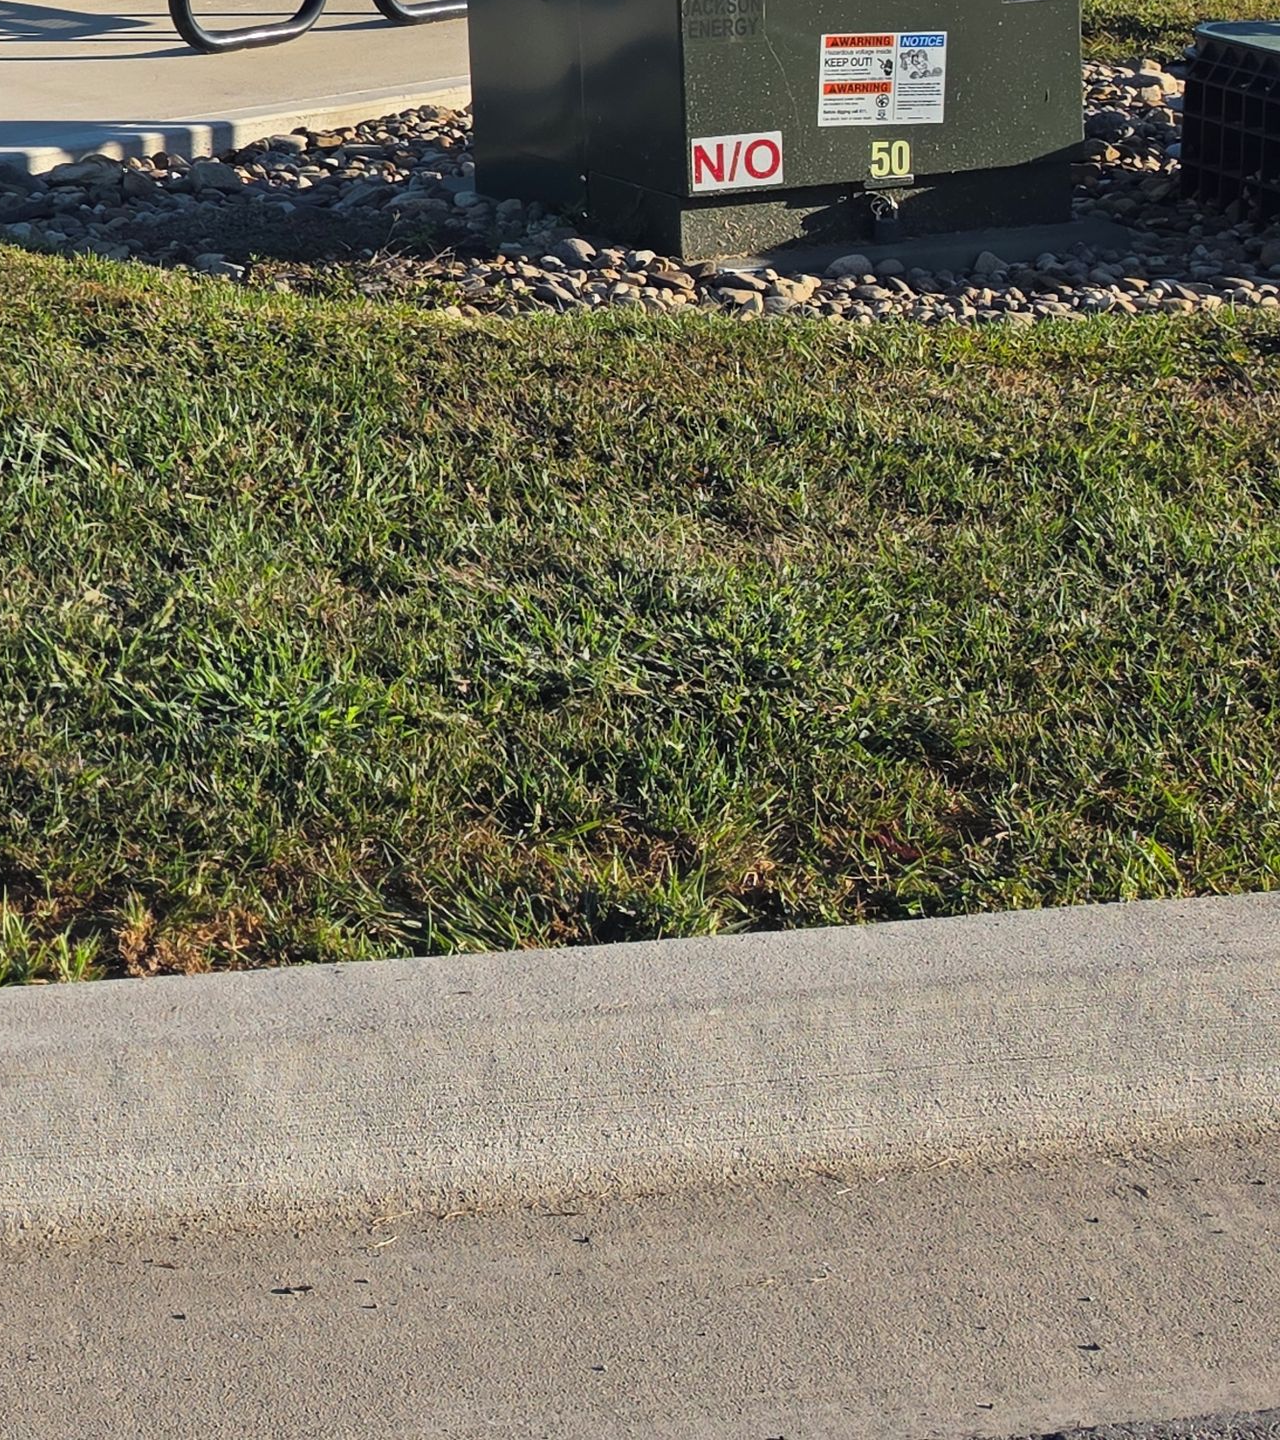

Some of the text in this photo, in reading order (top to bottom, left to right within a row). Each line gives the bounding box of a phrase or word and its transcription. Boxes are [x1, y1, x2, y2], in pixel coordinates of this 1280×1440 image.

[688, 17, 759, 39] ENERGY
[839, 35, 891, 47] WARNING
[901, 36, 943, 47] NOTICE
[824, 57, 872, 67] KEEP OUT!
[837, 82, 889, 94] WARNING
[694, 139, 781, 184] N/O
[871, 140, 910, 176] 50
